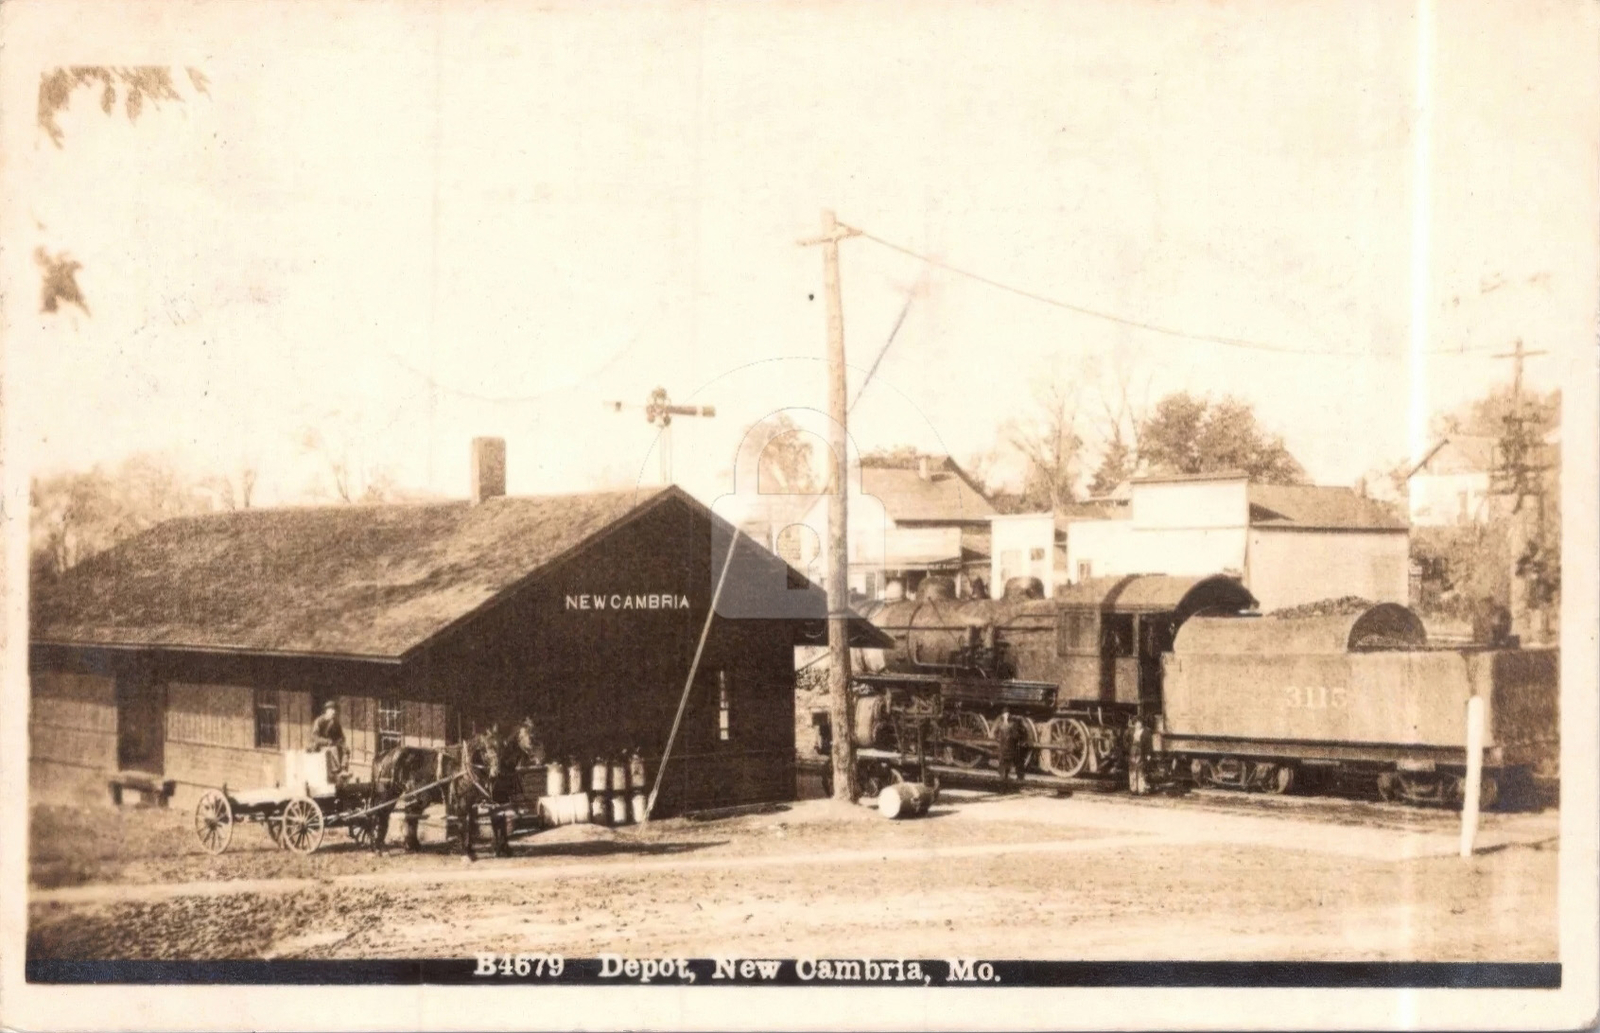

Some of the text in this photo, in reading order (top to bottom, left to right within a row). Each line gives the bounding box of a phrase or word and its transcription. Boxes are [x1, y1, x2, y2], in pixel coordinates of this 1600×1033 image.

[566, 594, 690, 610] NEW CAMBRIA
[1284, 685, 1348, 709] 3115
